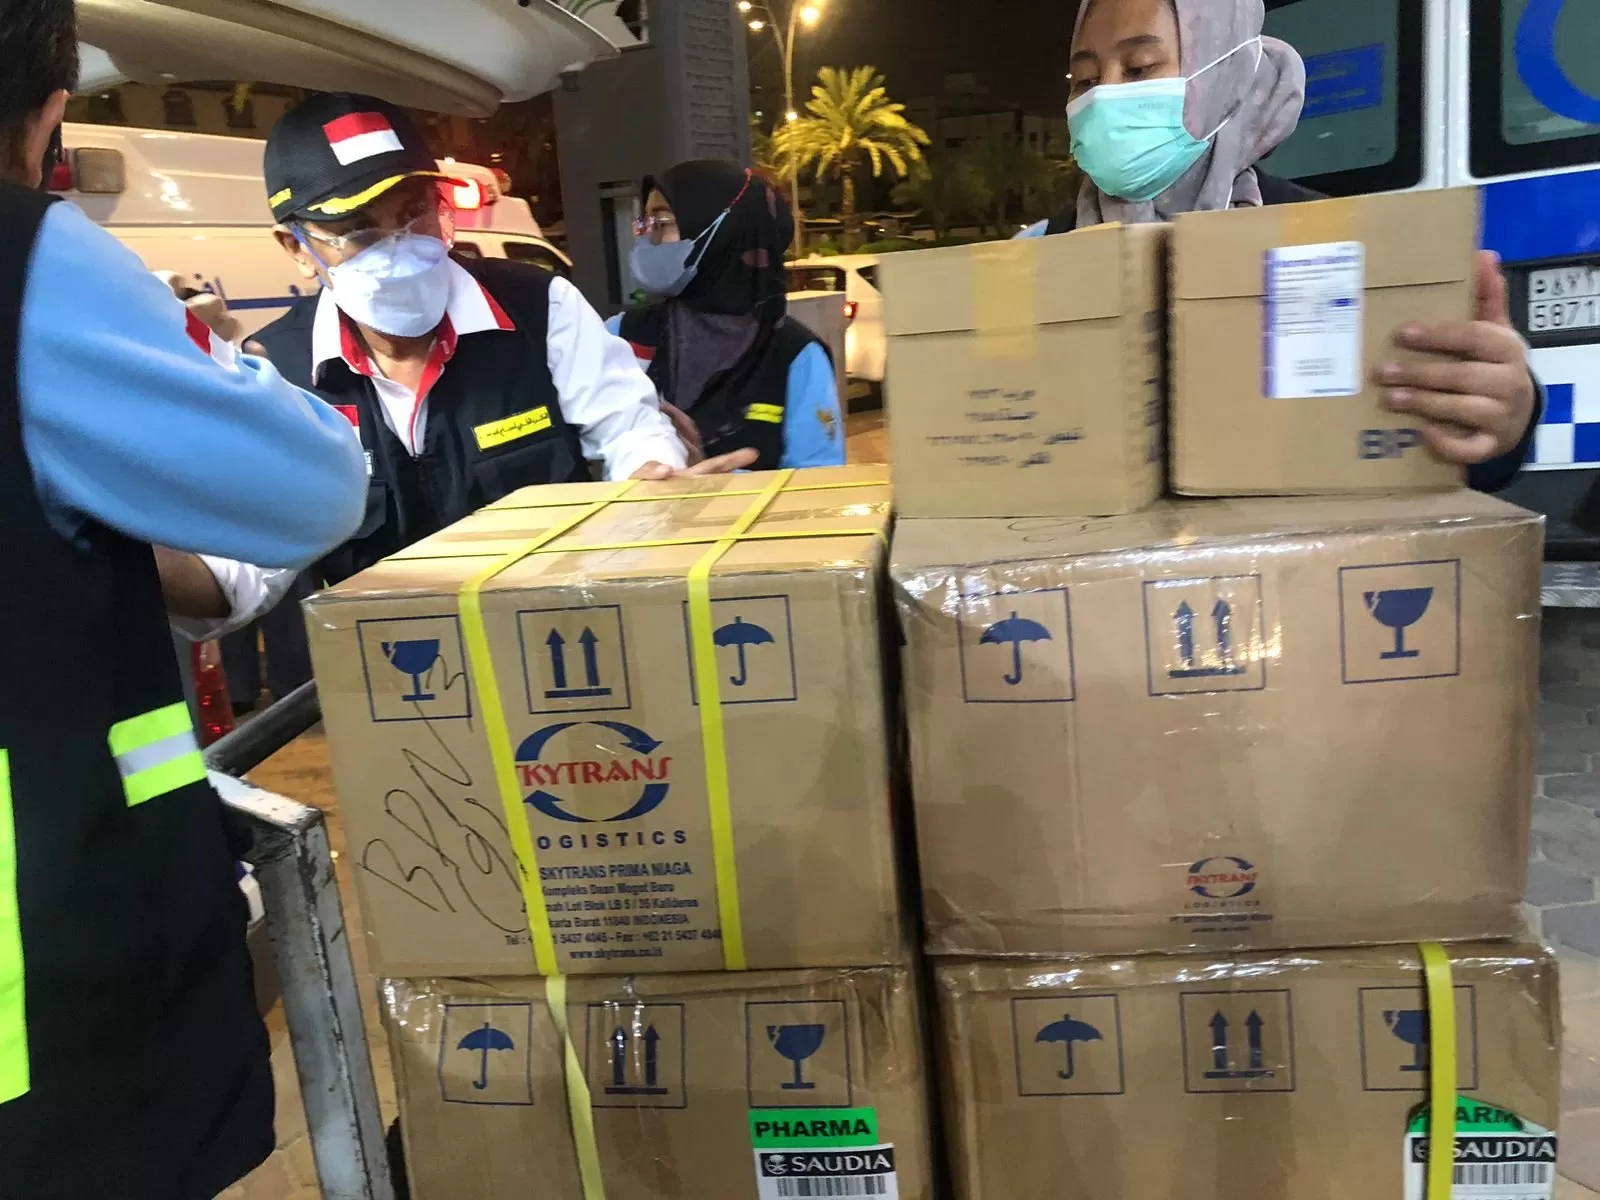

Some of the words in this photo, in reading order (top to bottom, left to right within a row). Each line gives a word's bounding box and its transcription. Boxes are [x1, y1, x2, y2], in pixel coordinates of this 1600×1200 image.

[1535, 300, 1596, 328] 5871
[515, 757, 672, 787] KYTRANS
[536, 829, 687, 850] OGISTICS
[539, 865, 605, 880] SKYTRANS
[608, 863, 649, 878] PRIMA
[651, 862, 693, 876] NIAGA
[632, 914, 690, 925] INDONESIA
[755, 1118, 871, 1138] PHARMA
[791, 1153, 892, 1173] SAUDIA
